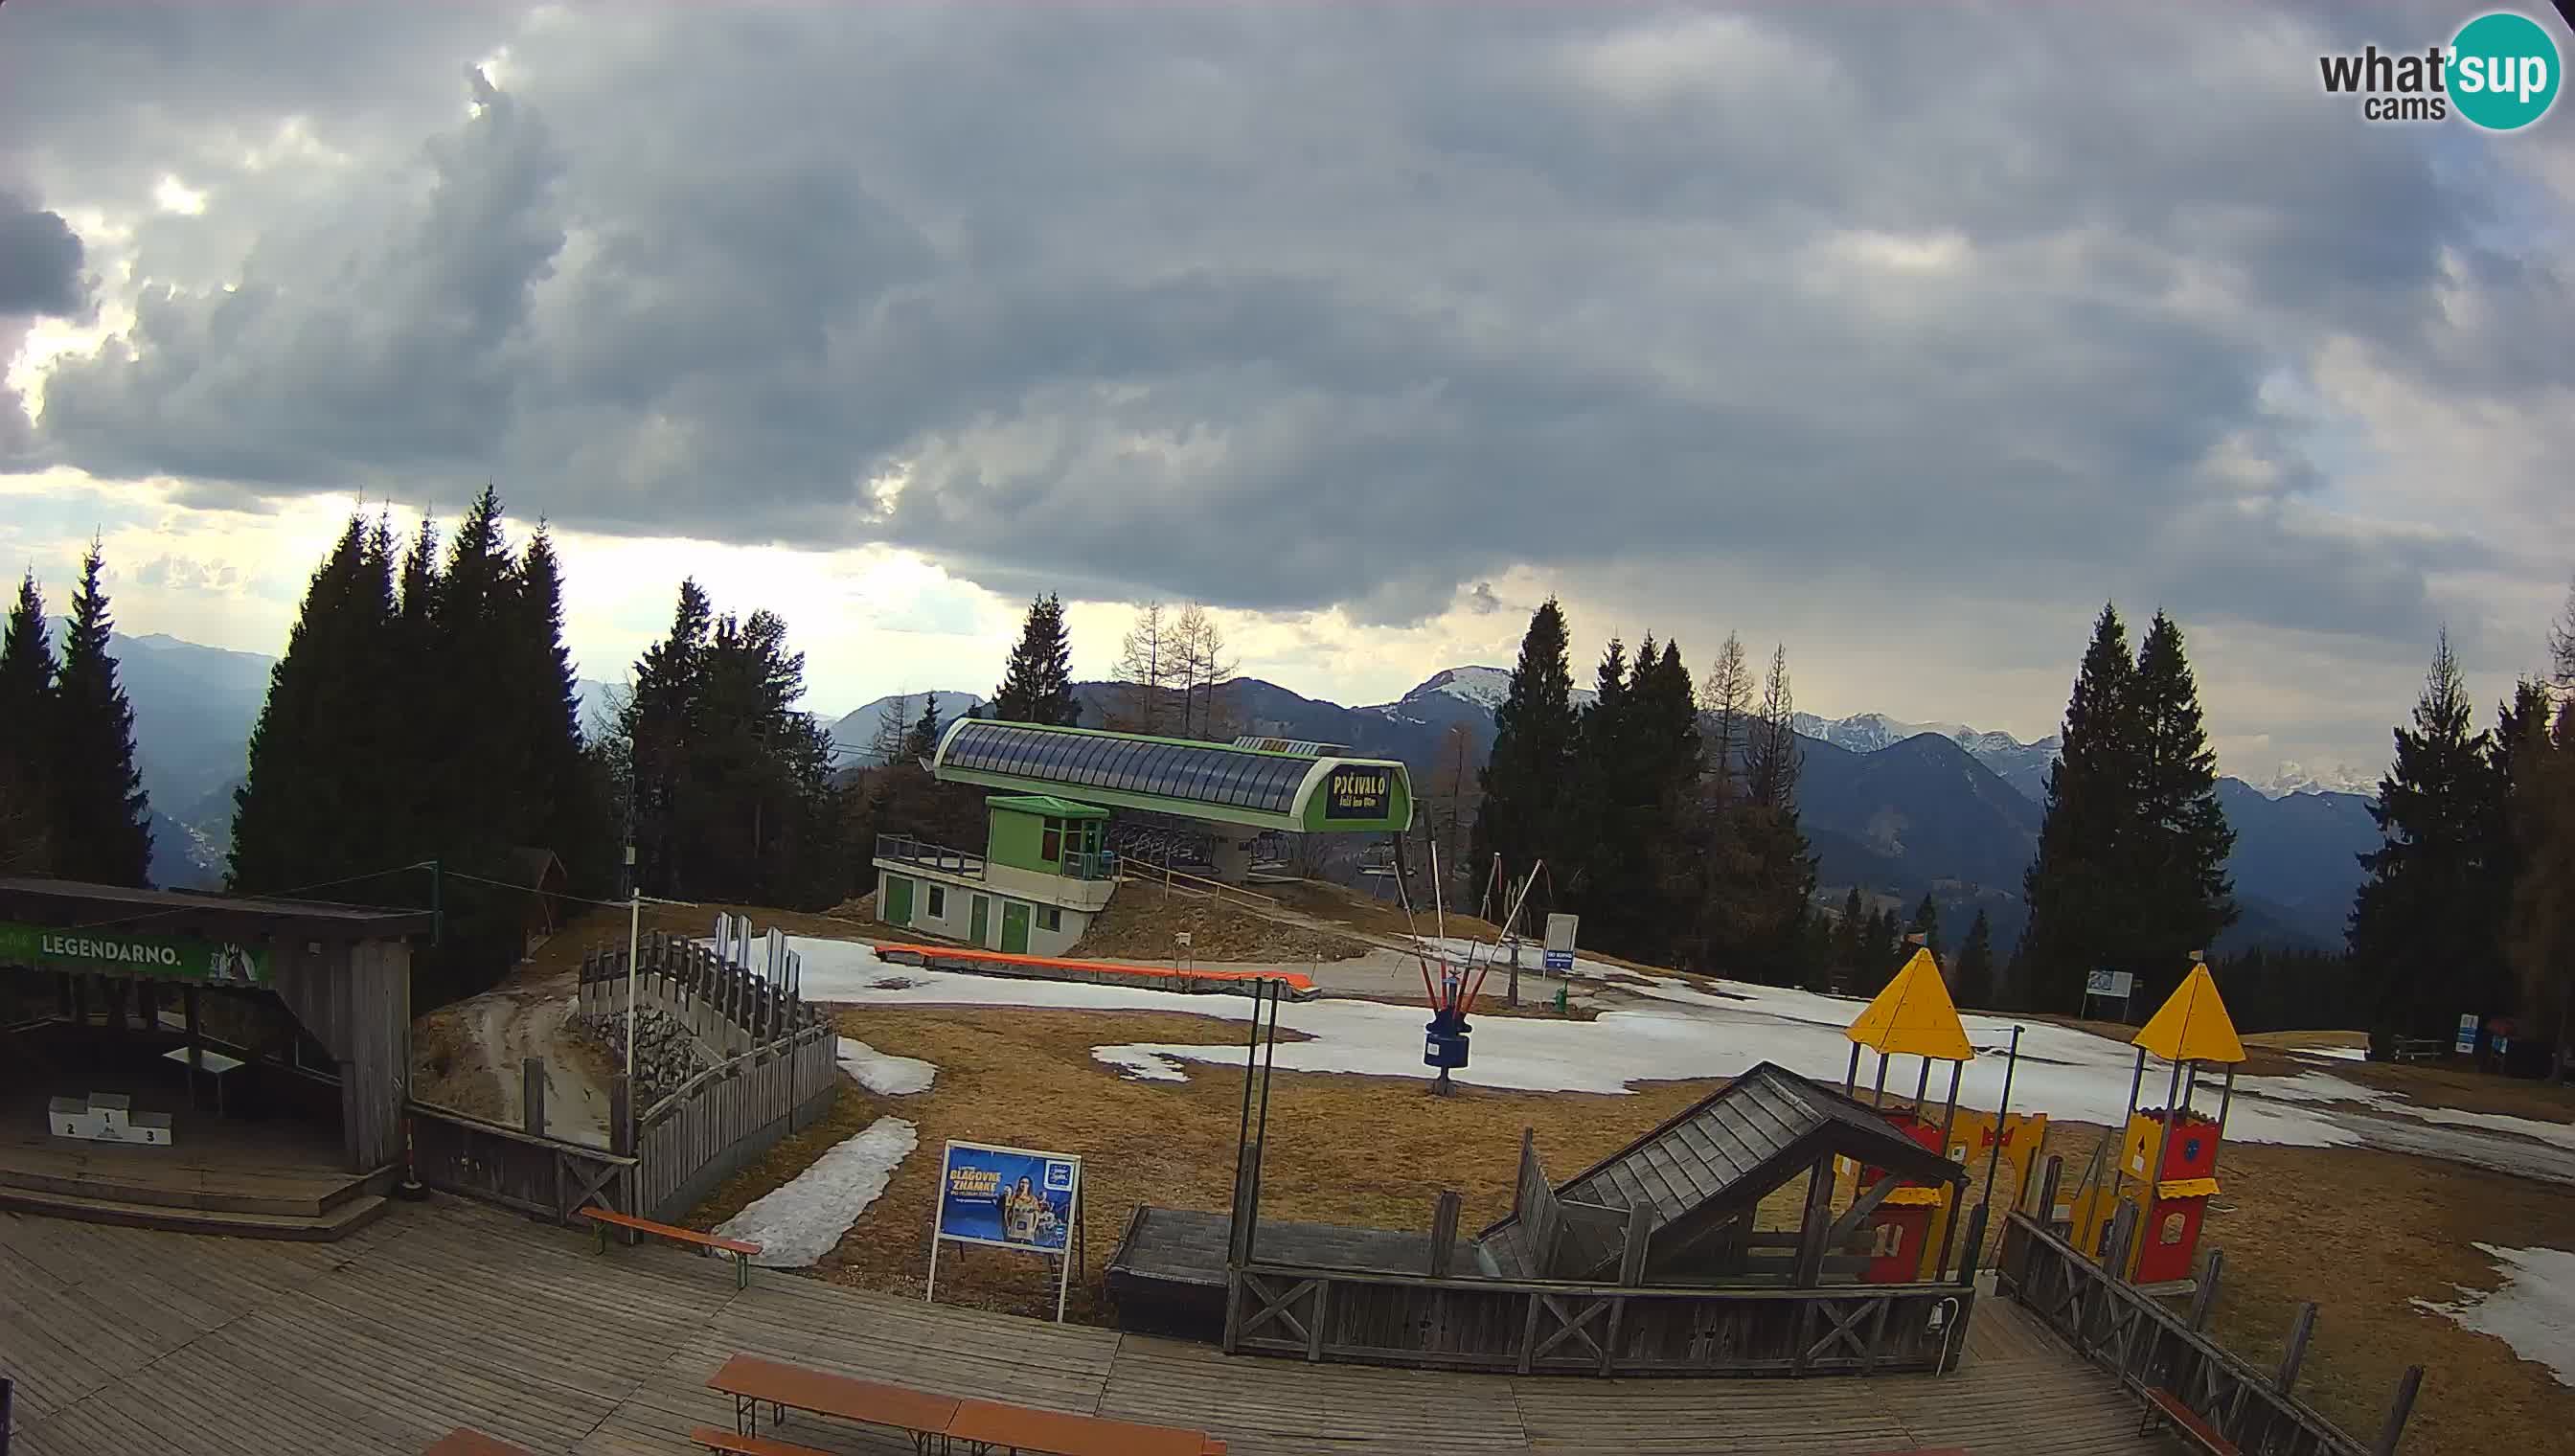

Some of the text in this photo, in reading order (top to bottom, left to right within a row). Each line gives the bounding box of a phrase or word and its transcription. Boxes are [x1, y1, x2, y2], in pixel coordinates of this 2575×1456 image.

[42, 935, 182, 966] LEGENDARNO.
[104, 1112, 111, 1123] 1
[67, 1124, 75, 1134] 2
[147, 1131, 155, 1142] 3
